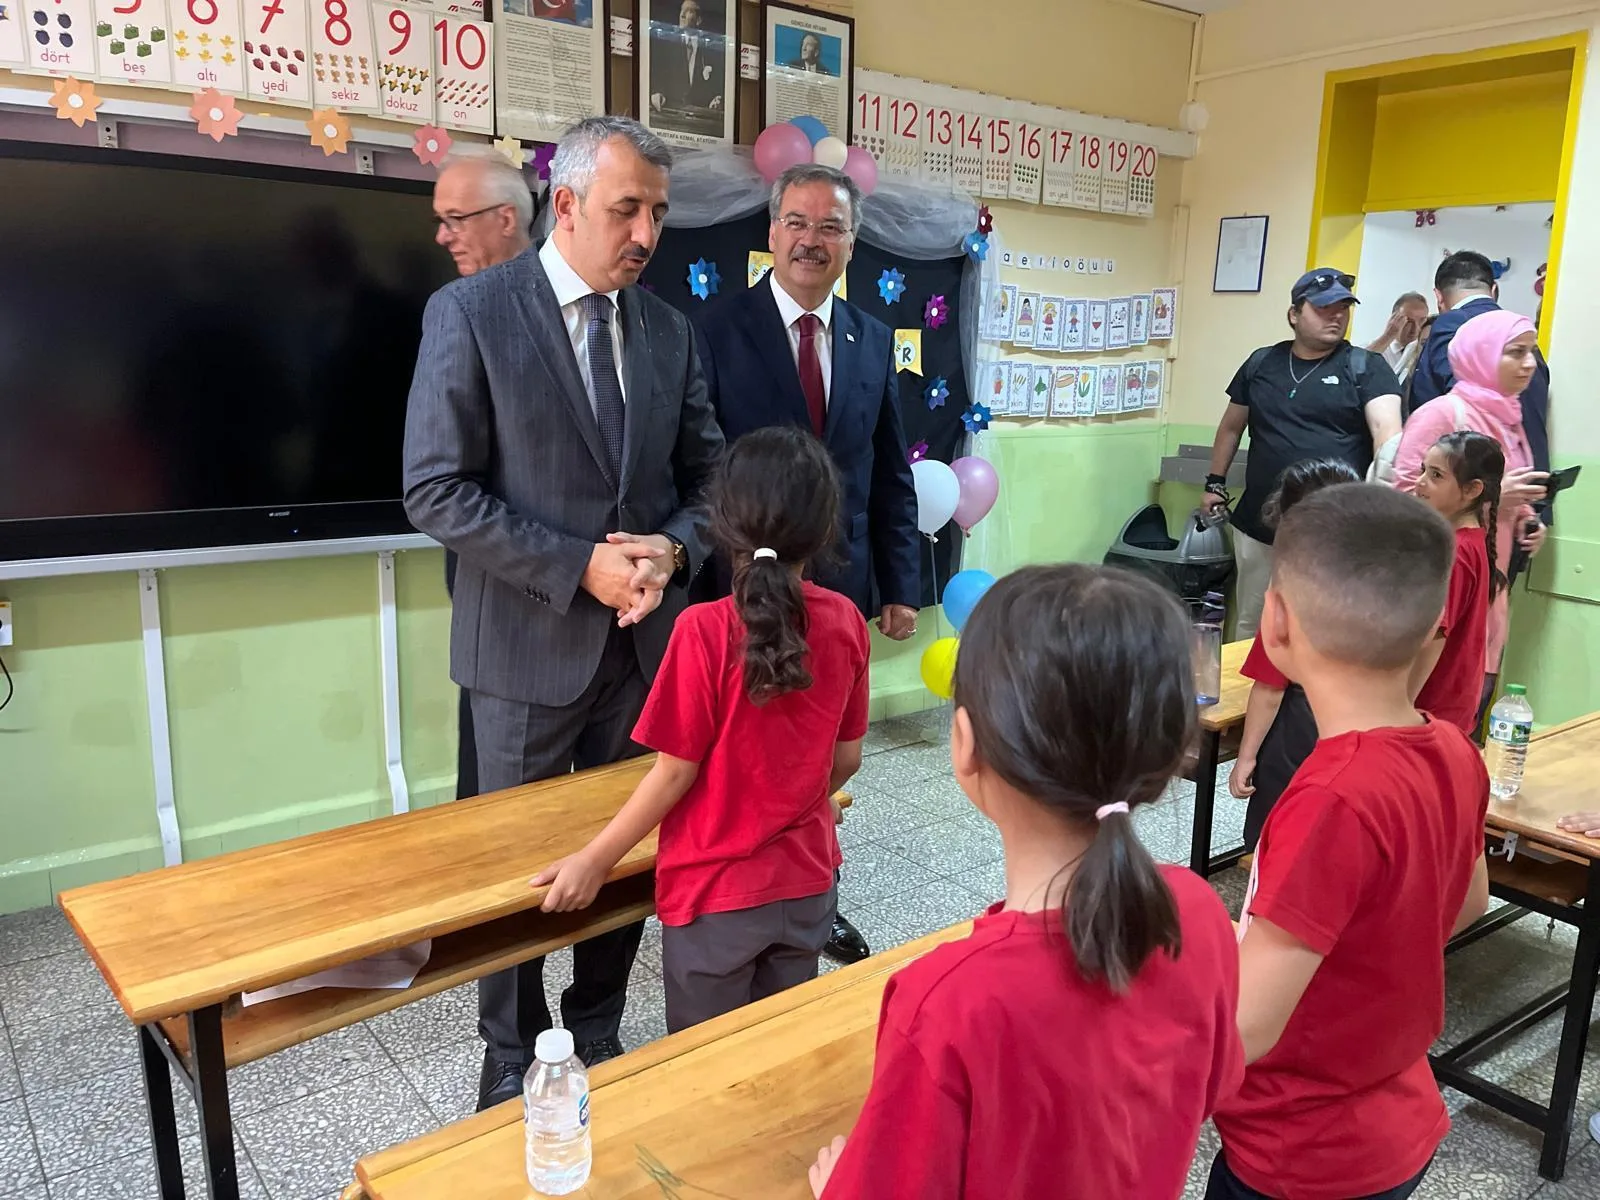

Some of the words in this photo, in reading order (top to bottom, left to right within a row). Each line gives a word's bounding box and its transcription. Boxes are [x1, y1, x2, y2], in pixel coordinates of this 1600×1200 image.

[324, 0, 352, 46] 8
[388, 9, 411, 56] 9
[40, 48, 71, 64] dört
[434, 19, 486, 71] 10
[123, 58, 146, 74] beş
[197, 69, 218, 83] altı
[262, 79, 289, 94] yedi
[331, 88, 360, 101] sekiz
[386, 96, 418, 112] dokuz
[453, 110, 467, 120] on
[858, 93, 881, 132] 11
[890, 99, 918, 139] 12
[926, 108, 952, 145] 13
[957, 113, 982, 150] 14
[987, 119, 1010, 154] 15
[1018, 123, 1042, 159] 16
[1050, 130, 1073, 164] 17
[1079, 135, 1100, 169] 18
[1108, 141, 1128, 173] 19
[1131, 144, 1156, 177] 20
[1003, 253, 1010, 262] a
[1021, 256, 1028, 265] e
[1063, 259, 1070, 268] o
[1077, 258, 1085, 270] ö
[1092, 262, 1098, 270] u
[1107, 260, 1113, 272] ü
[902, 347, 911, 362] R
